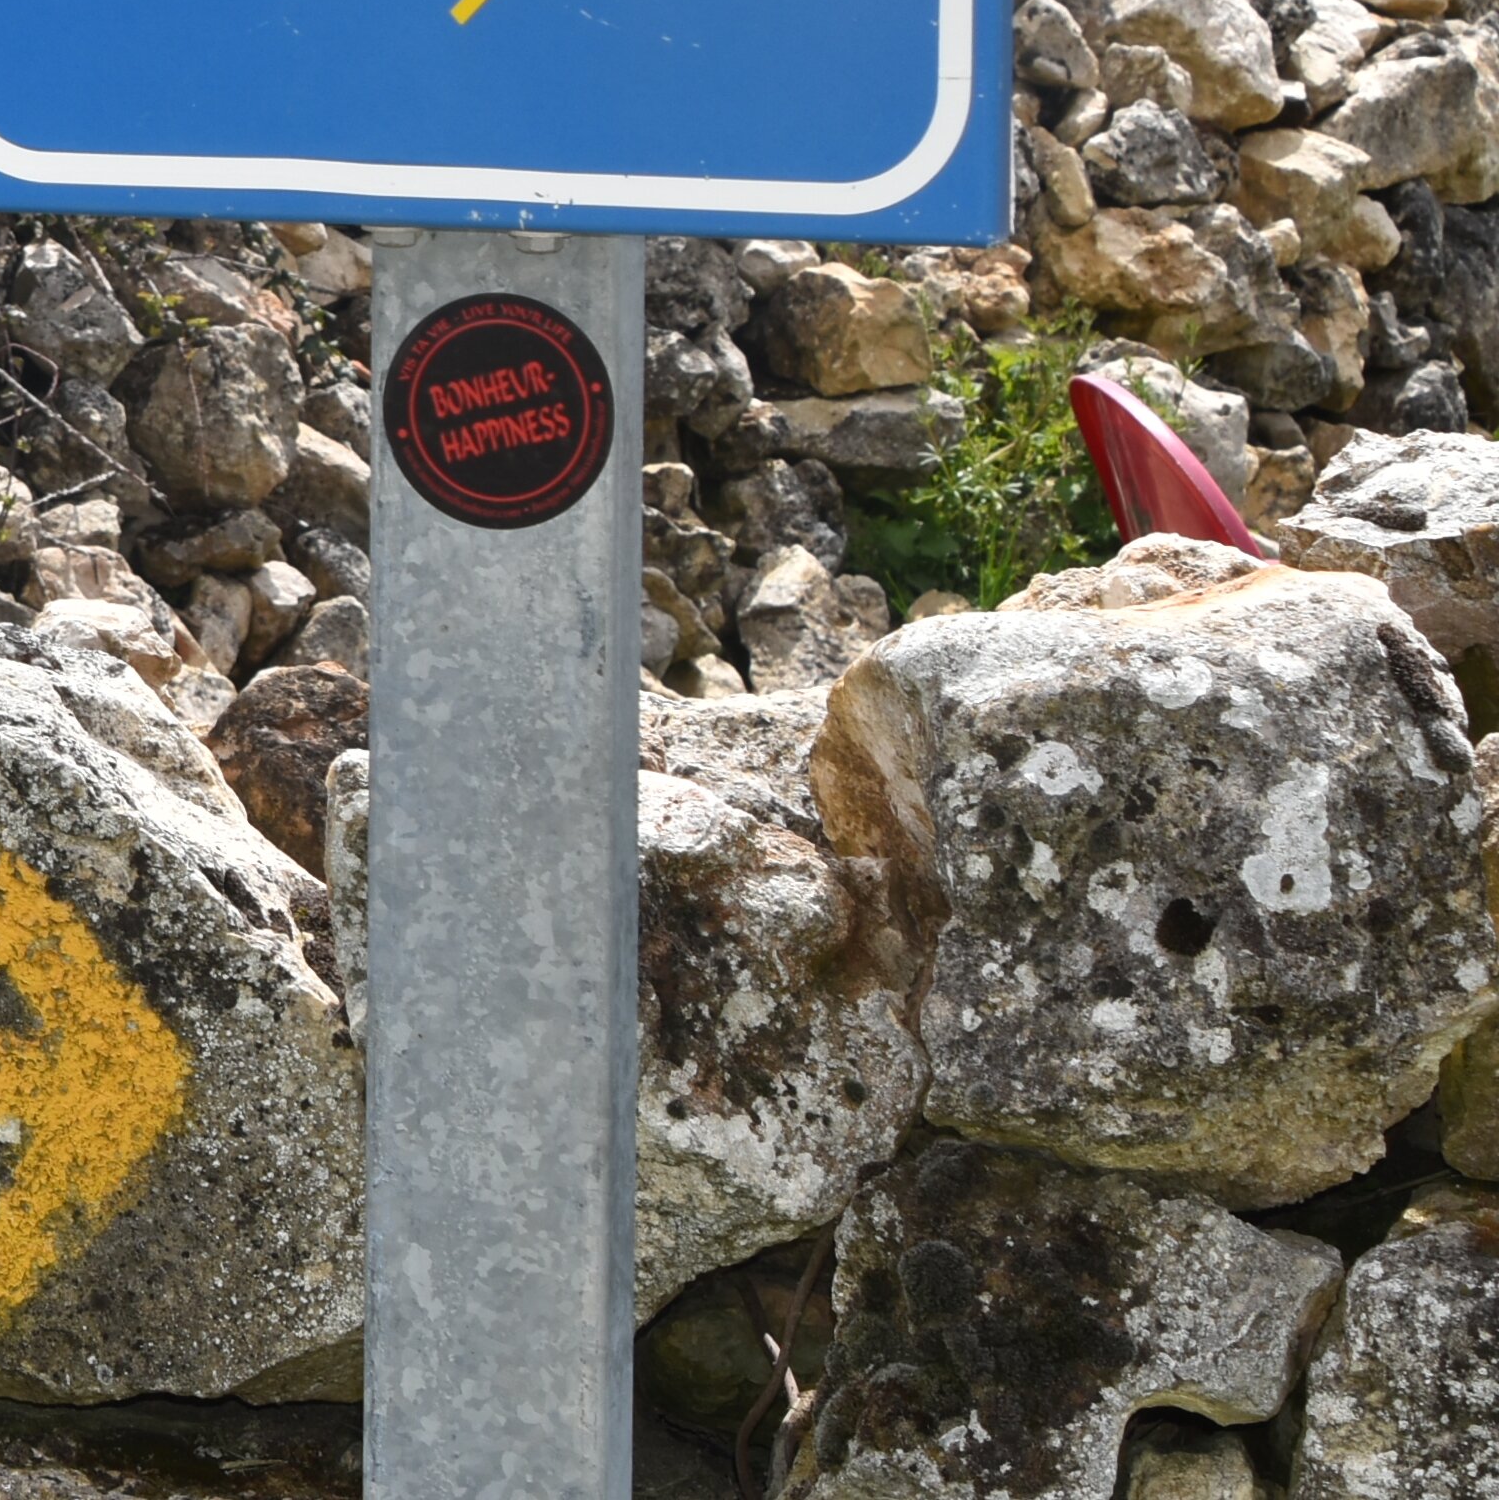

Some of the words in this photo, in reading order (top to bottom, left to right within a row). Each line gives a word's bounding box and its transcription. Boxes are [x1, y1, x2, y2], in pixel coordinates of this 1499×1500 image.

[410, 339, 430, 355] TA
[461, 303, 495, 321] LIVE
[500, 303, 543, 324] YOUR
[440, 402, 571, 464] HAPPINESS
